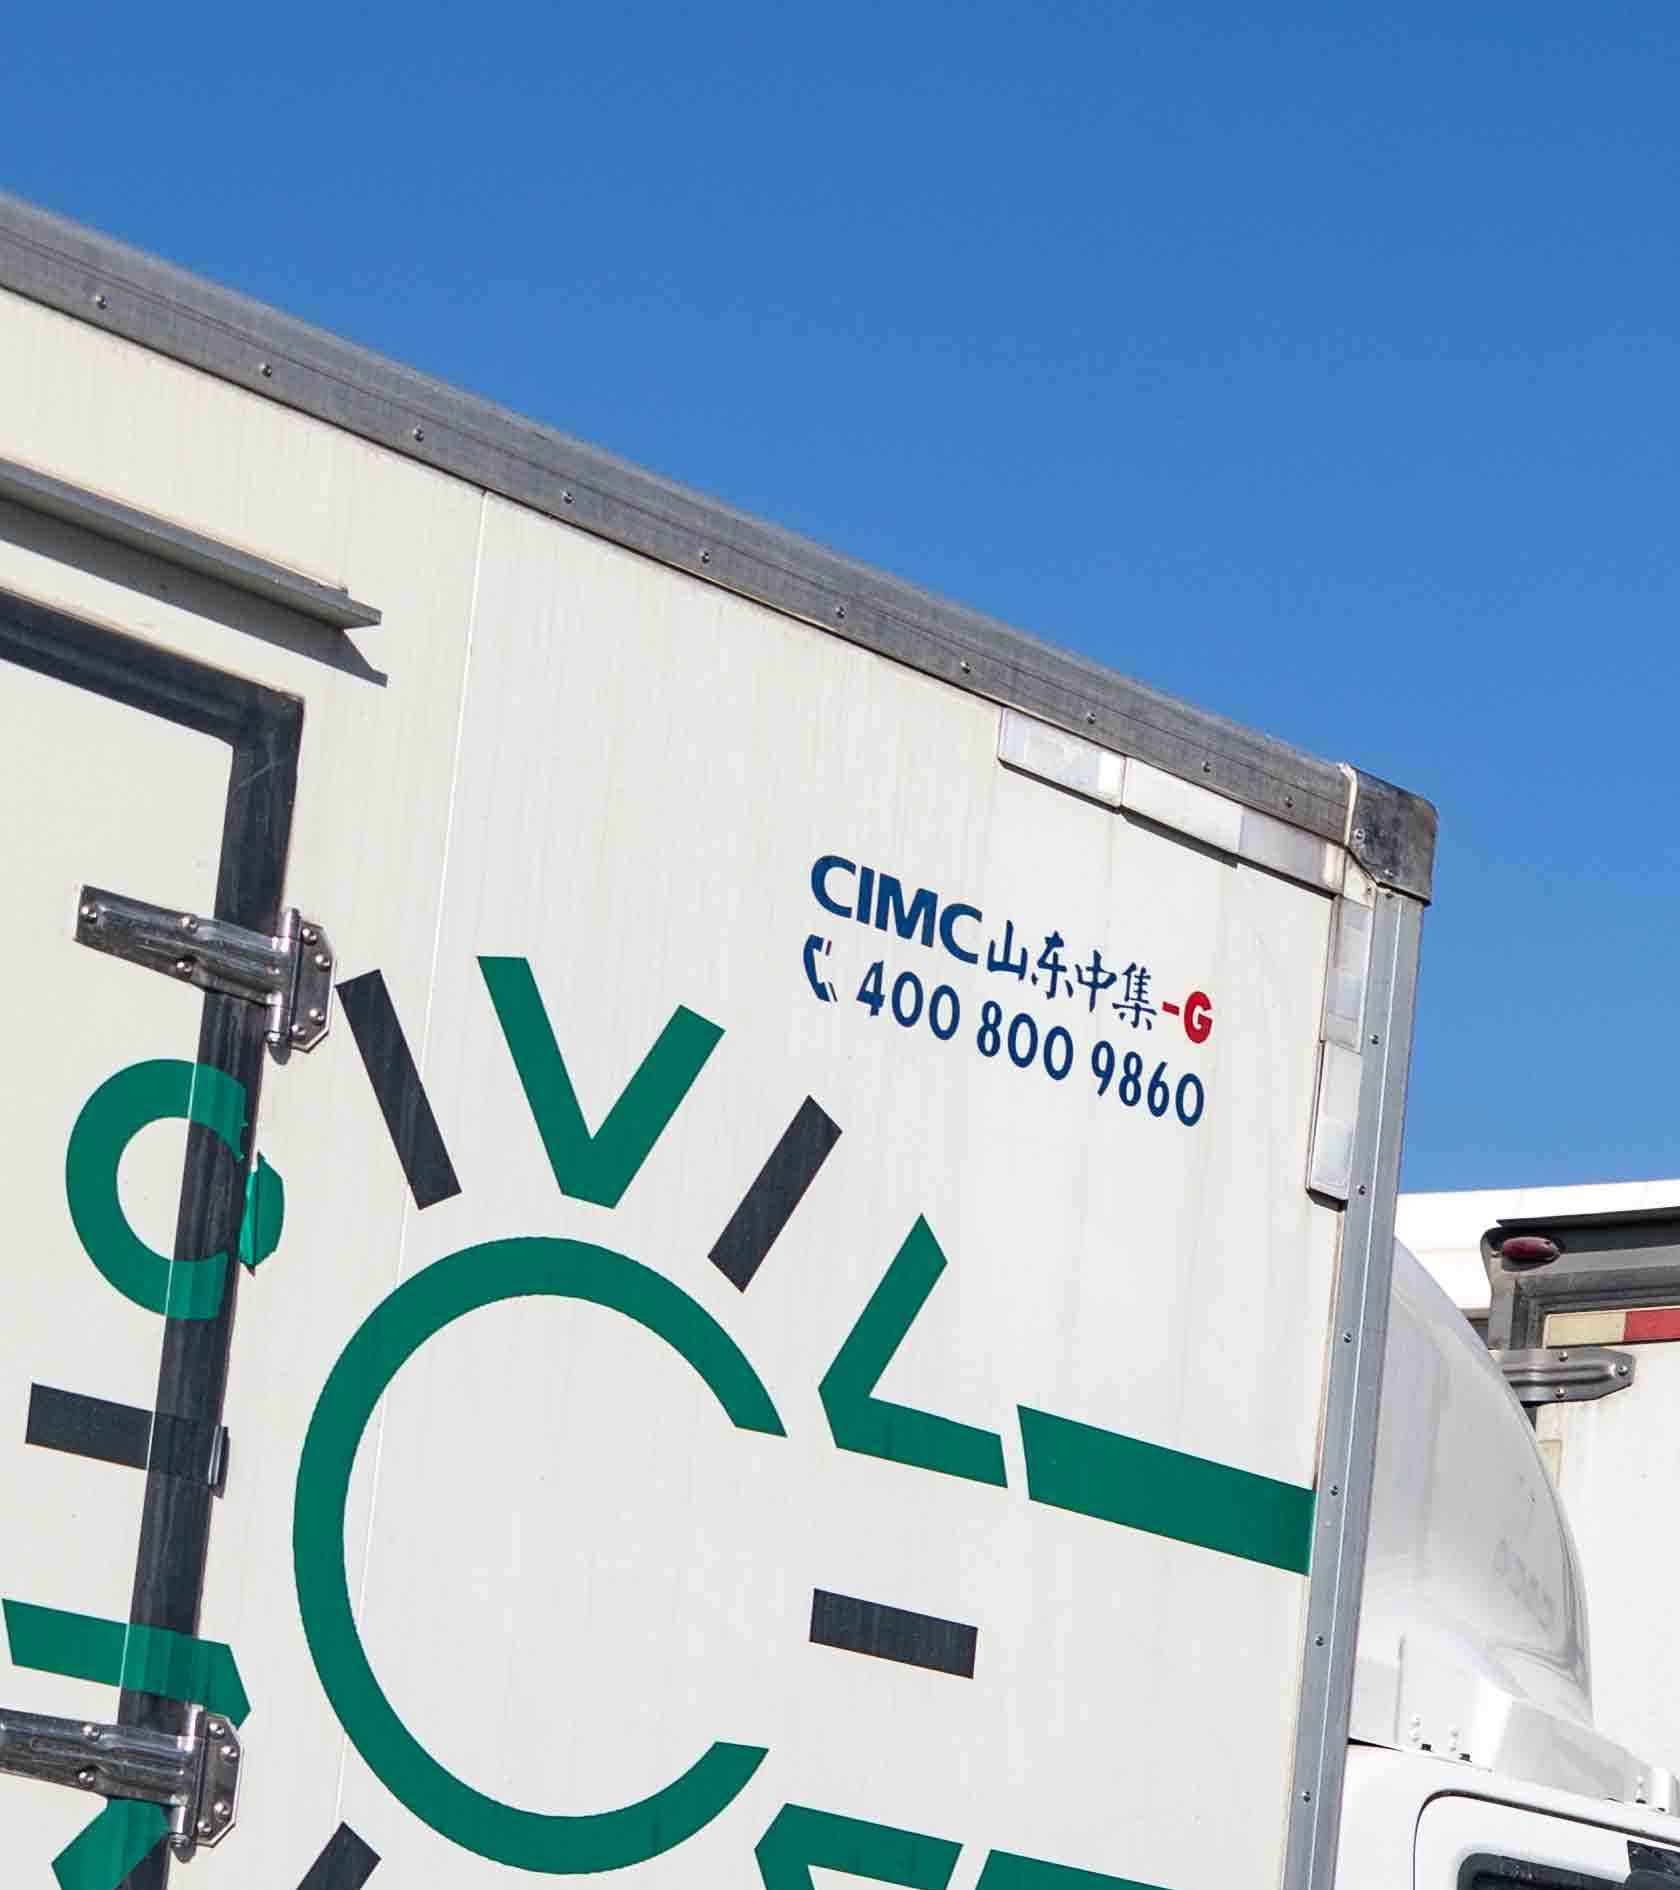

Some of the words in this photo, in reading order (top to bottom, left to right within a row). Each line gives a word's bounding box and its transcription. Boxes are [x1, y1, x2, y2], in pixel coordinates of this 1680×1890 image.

[855, 960, 960, 1041] 400
[976, 1000, 1074, 1081] 800
[1091, 1040, 1205, 1127] 9860
